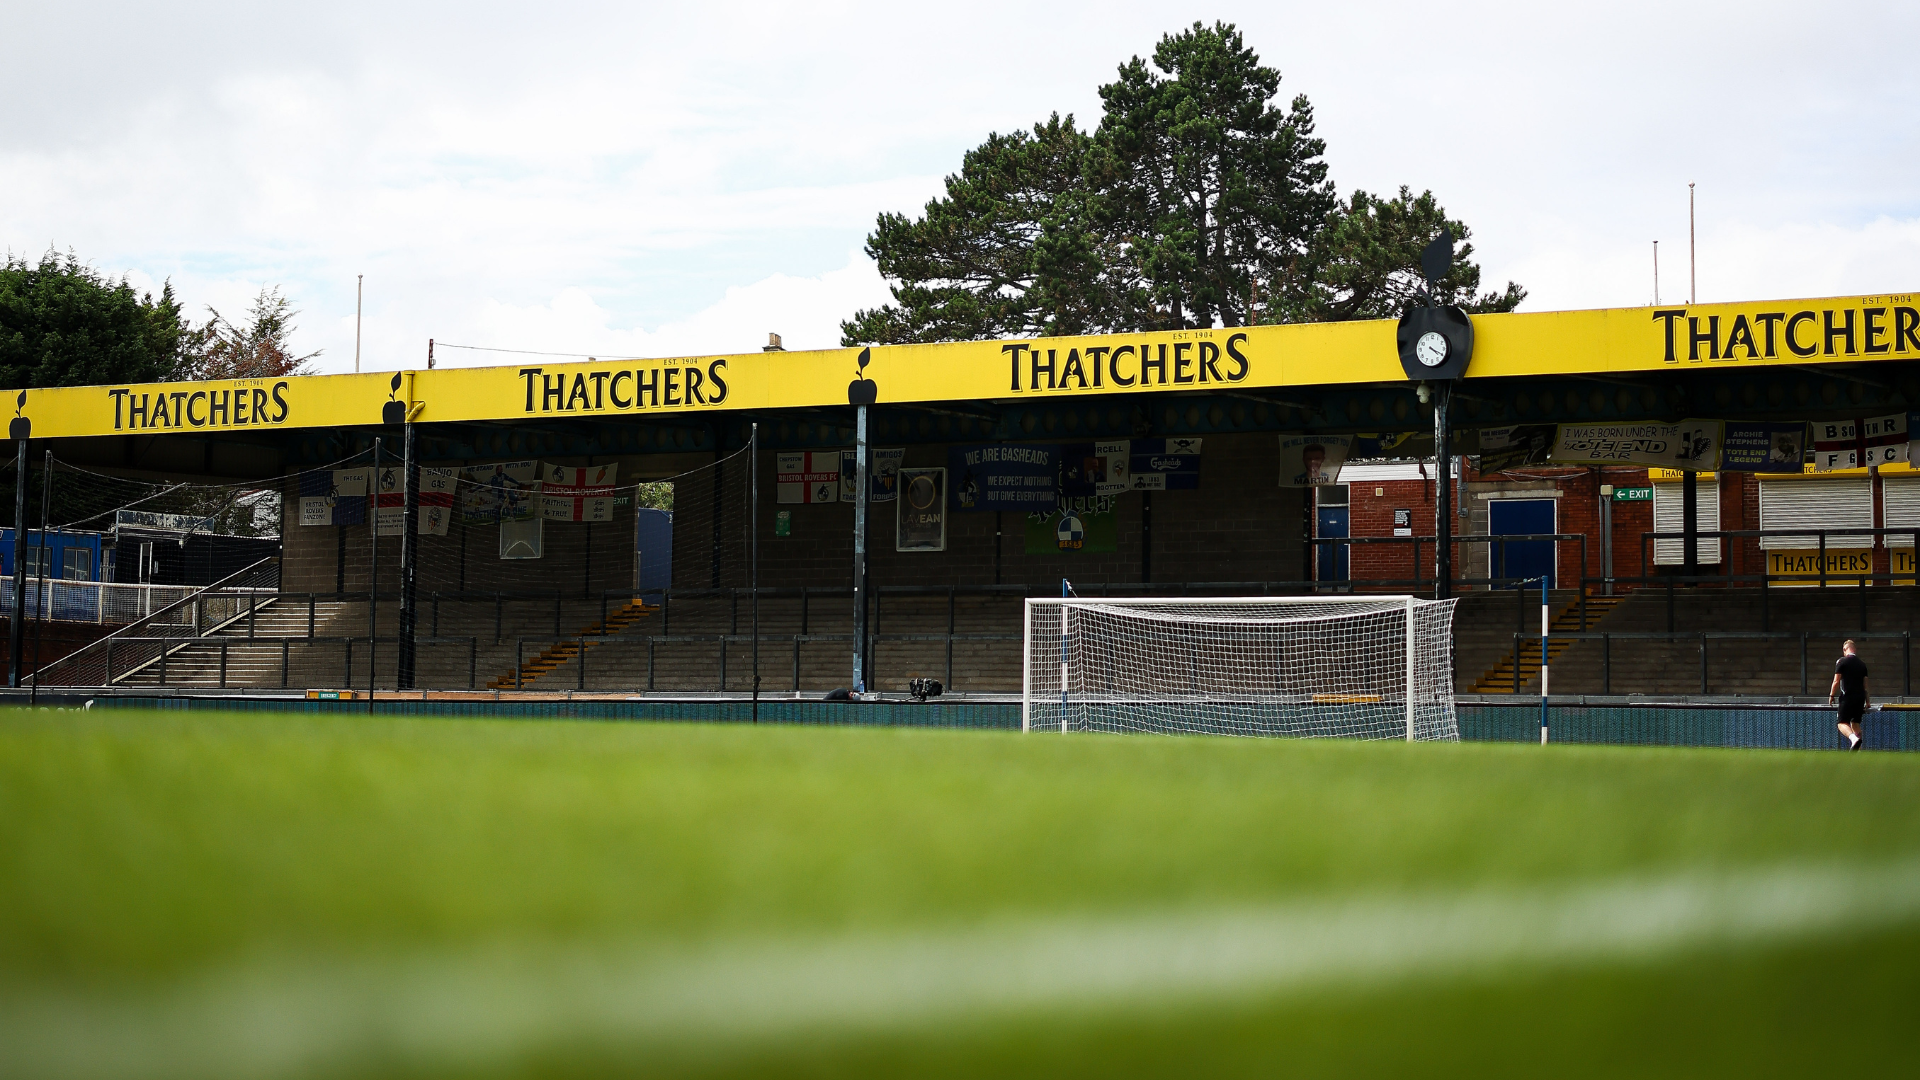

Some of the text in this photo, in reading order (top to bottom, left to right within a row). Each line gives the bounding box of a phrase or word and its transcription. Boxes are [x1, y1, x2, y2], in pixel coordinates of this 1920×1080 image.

[1889, 296, 1912, 304] 1904
[1001, 333, 1251, 392] THATCHERS
[519, 359, 729, 414] THATCHERS
[108, 381, 290, 431] THATCHERS
[1566, 426, 1678, 438] I WAS BORN UNDER THE
[1825, 425, 1837, 438] B
[1884, 419, 1896, 432] R
[1304, 436, 1319, 444] NEVER
[1564, 438, 1667, 453] TOTE END
[876, 450, 902, 458] AMIGOS
[965, 450, 980, 466] WE
[982, 448, 999, 464] ARE
[1001, 447, 1049, 466] GASHEADS
[1726, 448, 1748, 456] TOTE
[1829, 454, 1838, 466] F
[1884, 448, 1896, 460] C
[476, 464, 494, 472] STAND
[1150, 457, 1182, 470] Gasheads
[778, 474, 803, 482] BRISTOL
[988, 476, 1052, 486] WE EXPECT NOTHING
[1294, 476, 1328, 484] MARTIN
[431, 480, 446, 488] GAS
[544, 486, 574, 496] BRISTOL
[987, 490, 1055, 502] BUT GIVE EVERYTHING
[1629, 490, 1650, 498] EXIT
[464, 508, 501, 520] TOGETHE
[901, 514, 940, 524] LAVEAN
